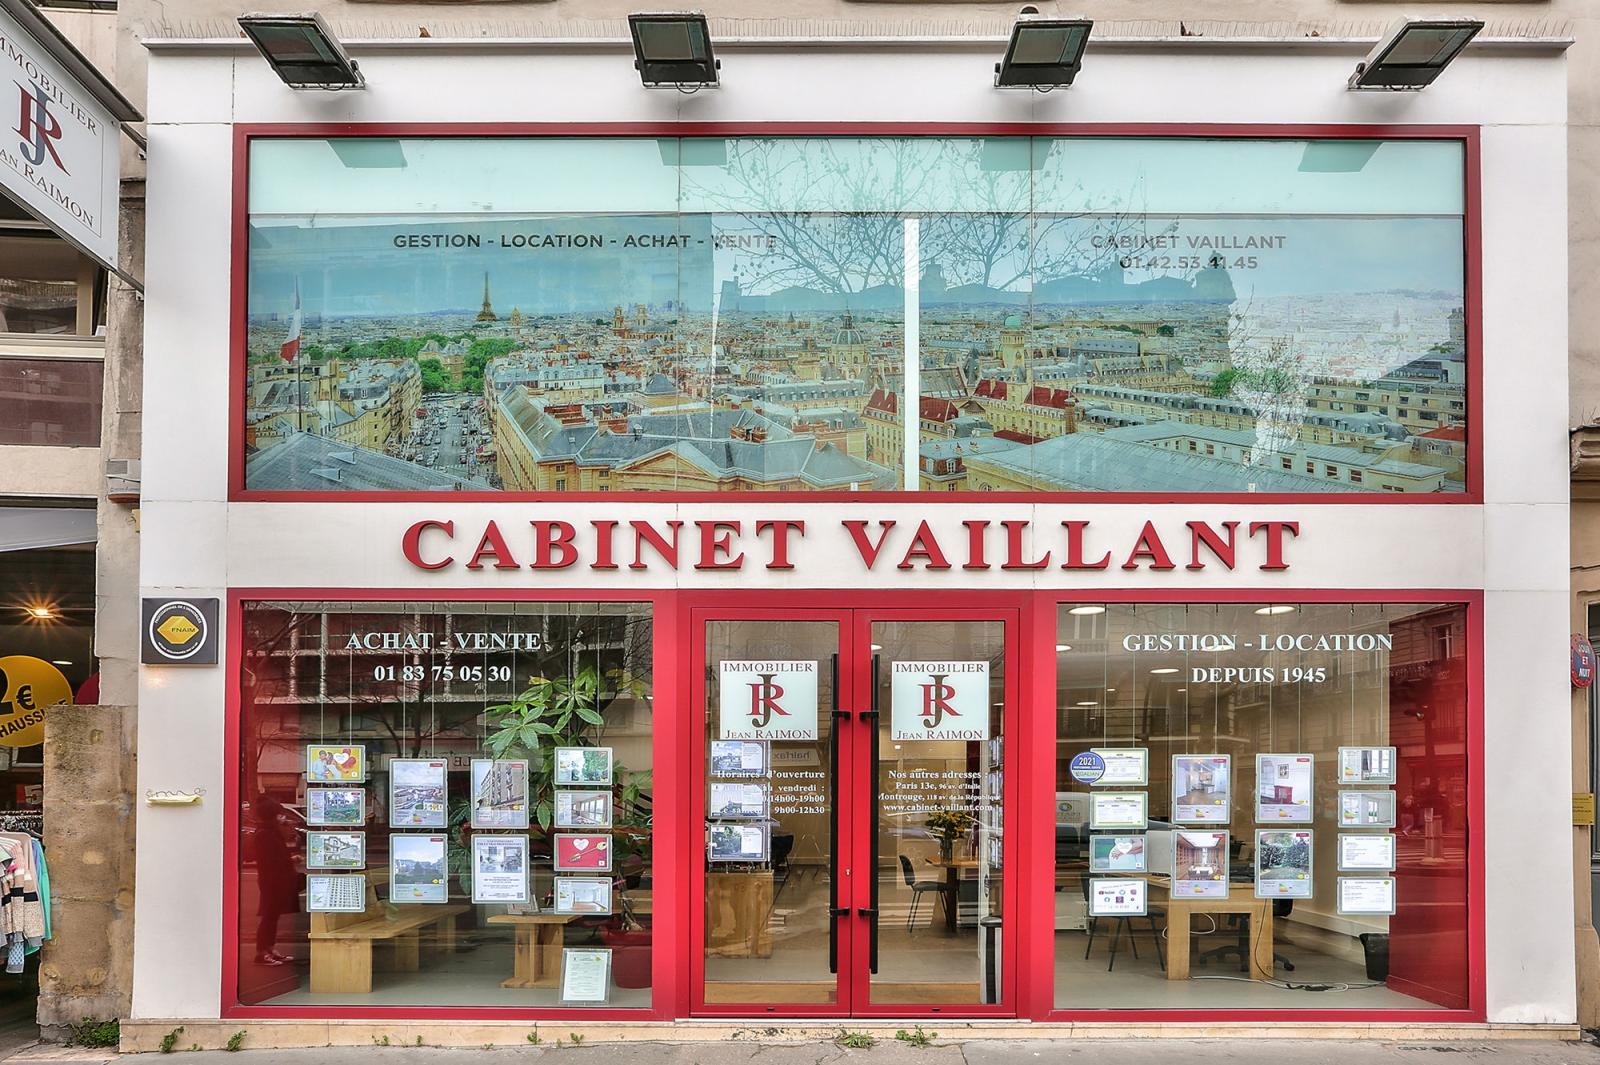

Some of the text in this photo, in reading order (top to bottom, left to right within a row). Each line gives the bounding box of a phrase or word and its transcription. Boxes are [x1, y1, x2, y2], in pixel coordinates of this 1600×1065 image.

[24, 163, 94, 228] RAIMON
[393, 234, 481, 248] GESTION
[501, 234, 604, 248] LOCATION
[623, 234, 691, 248] ACHAT
[711, 234, 778, 248] VENTE
[1090, 235, 1287, 249] CABINET VAILLANT
[1119, 256, 1258, 269] 01.42.53.41.45
[402, 519, 1300, 571] CABINET VAILLANT
[345, 632, 434, 650] ACHAT
[454, 632, 541, 650] VENTE
[1122, 634, 1237, 651] GESTION
[1259, 634, 1394, 651] LOCATION
[374, 665, 511, 681] 01 83 75 05 30
[723, 663, 813, 673] IMMOBILIER
[895, 663, 985, 673] IMMOBILIER
[1192, 667, 1326, 683] DEPUIS 1945
[755, 729, 812, 739] RAIMON
[928, 730, 984, 739] RAIMON
[1079, 757, 1096, 766] 2021
[888, 770, 907, 779] Nos
[909, 771, 939, 779] autres
[942, 770, 982, 779] adresses
[778, 784, 817, 792] vendredi
[896, 782, 918, 790] Paris
[920, 782, 937, 791] 13e,
[774, 806, 825, 814] 9h00-12h30
[883, 803, 993, 811] www.cabinet-vaillant.com
